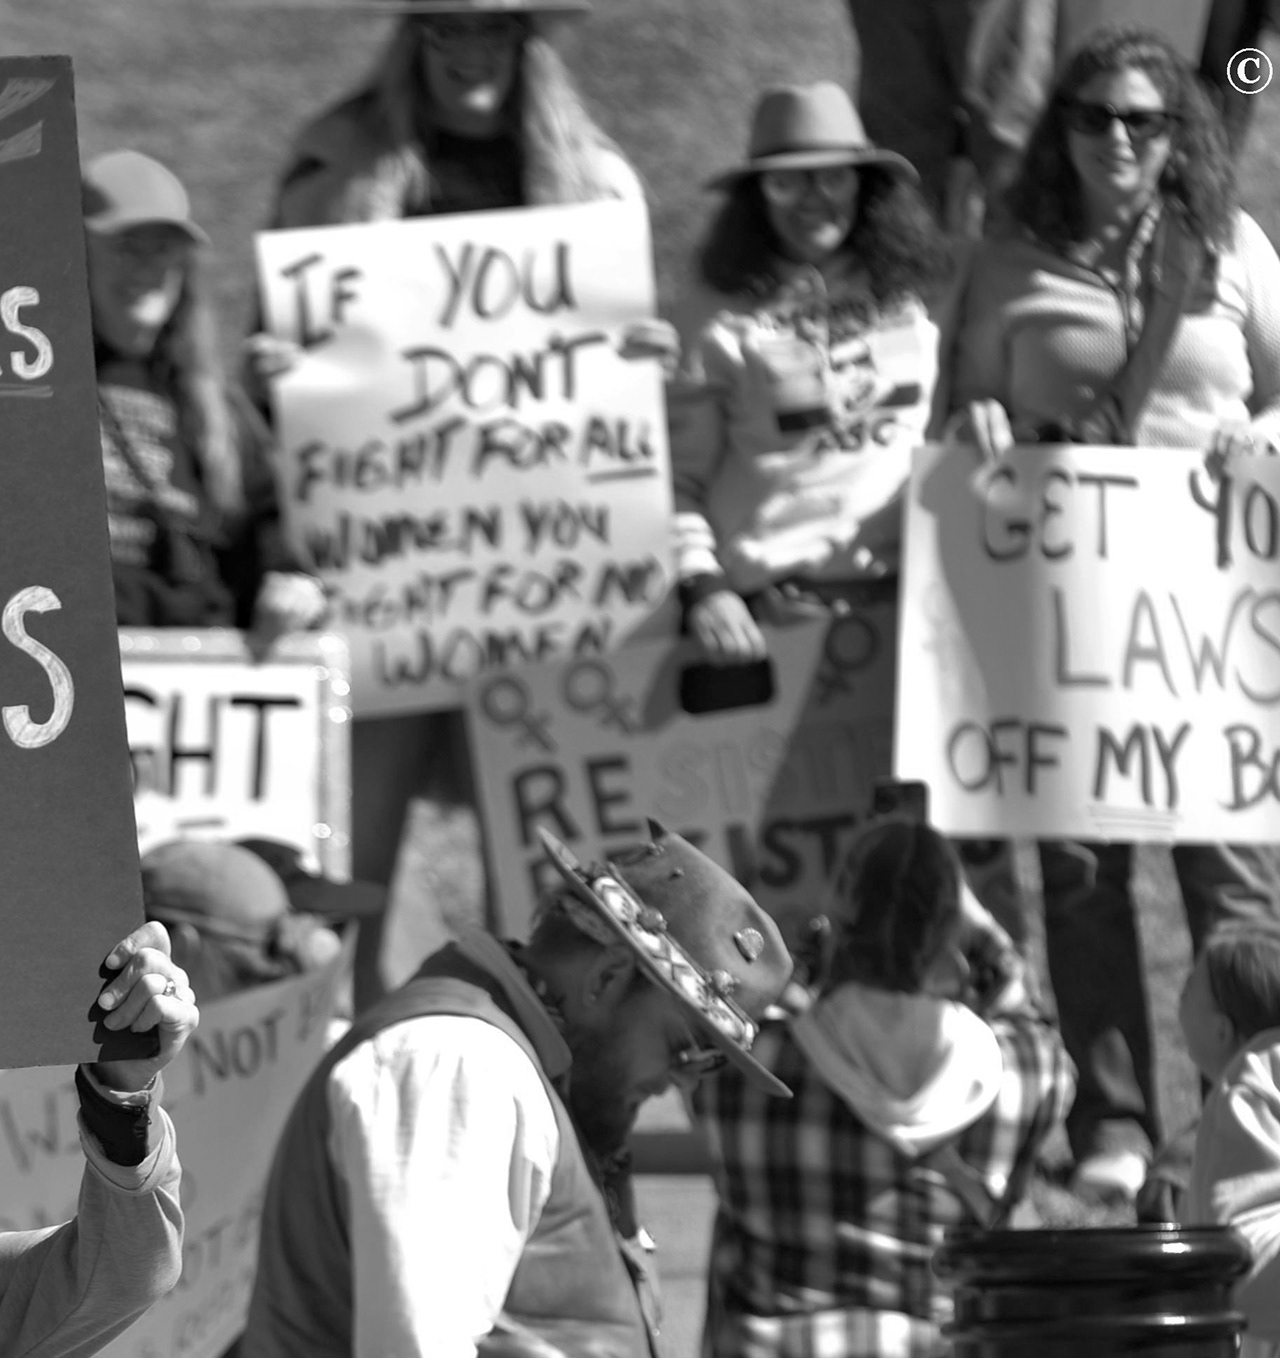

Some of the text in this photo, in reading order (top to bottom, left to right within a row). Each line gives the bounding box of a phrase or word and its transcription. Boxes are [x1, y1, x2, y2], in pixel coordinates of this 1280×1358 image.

[281, 242, 578, 352] IF YOU
[296, 414, 655, 504] FIGHT FOR ALL
[521, 500, 612, 553] YOU
[982, 465, 1139, 562] GET
[479, 557, 584, 615] FOR
[374, 615, 613, 687] WOMEN
[945, 717, 1068, 796] OFF
[1094, 720, 1193, 810] MY
[188, 1007, 288, 1097] NOT
